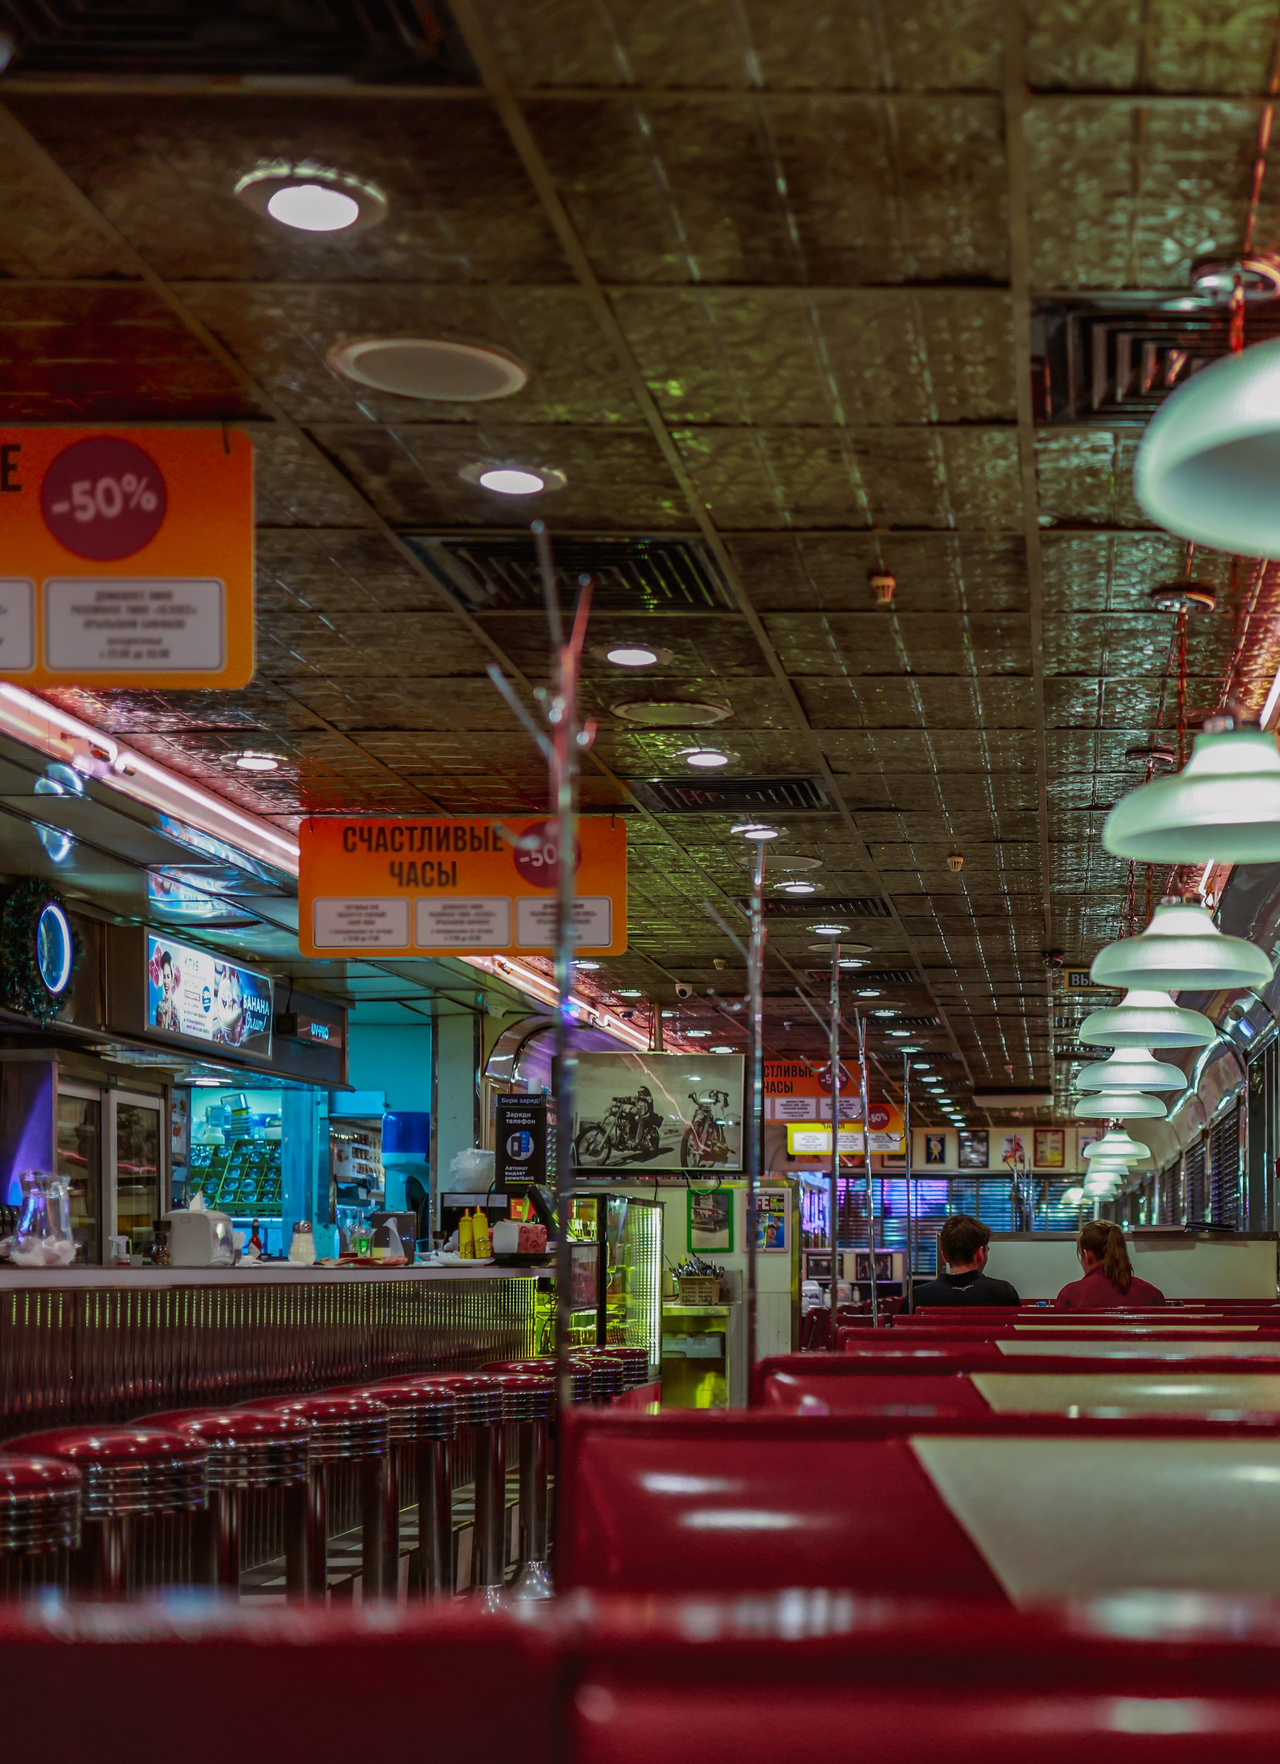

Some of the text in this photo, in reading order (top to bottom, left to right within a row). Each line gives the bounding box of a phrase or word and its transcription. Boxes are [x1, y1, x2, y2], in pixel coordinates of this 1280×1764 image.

[0, 444, 22, 492] Е
[51, 473, 158, 523] -50%
[343, 826, 505, 852] СЧАСТЛИВЫЕ
[519, 843, 575, 867] -50
[389, 861, 457, 887] ЧАСЫ
[243, 994, 270, 1016] БАНАНА
[763, 1065, 814, 1078] СТЛИВЫЕ
[820, 1073, 847, 1085] -5%
